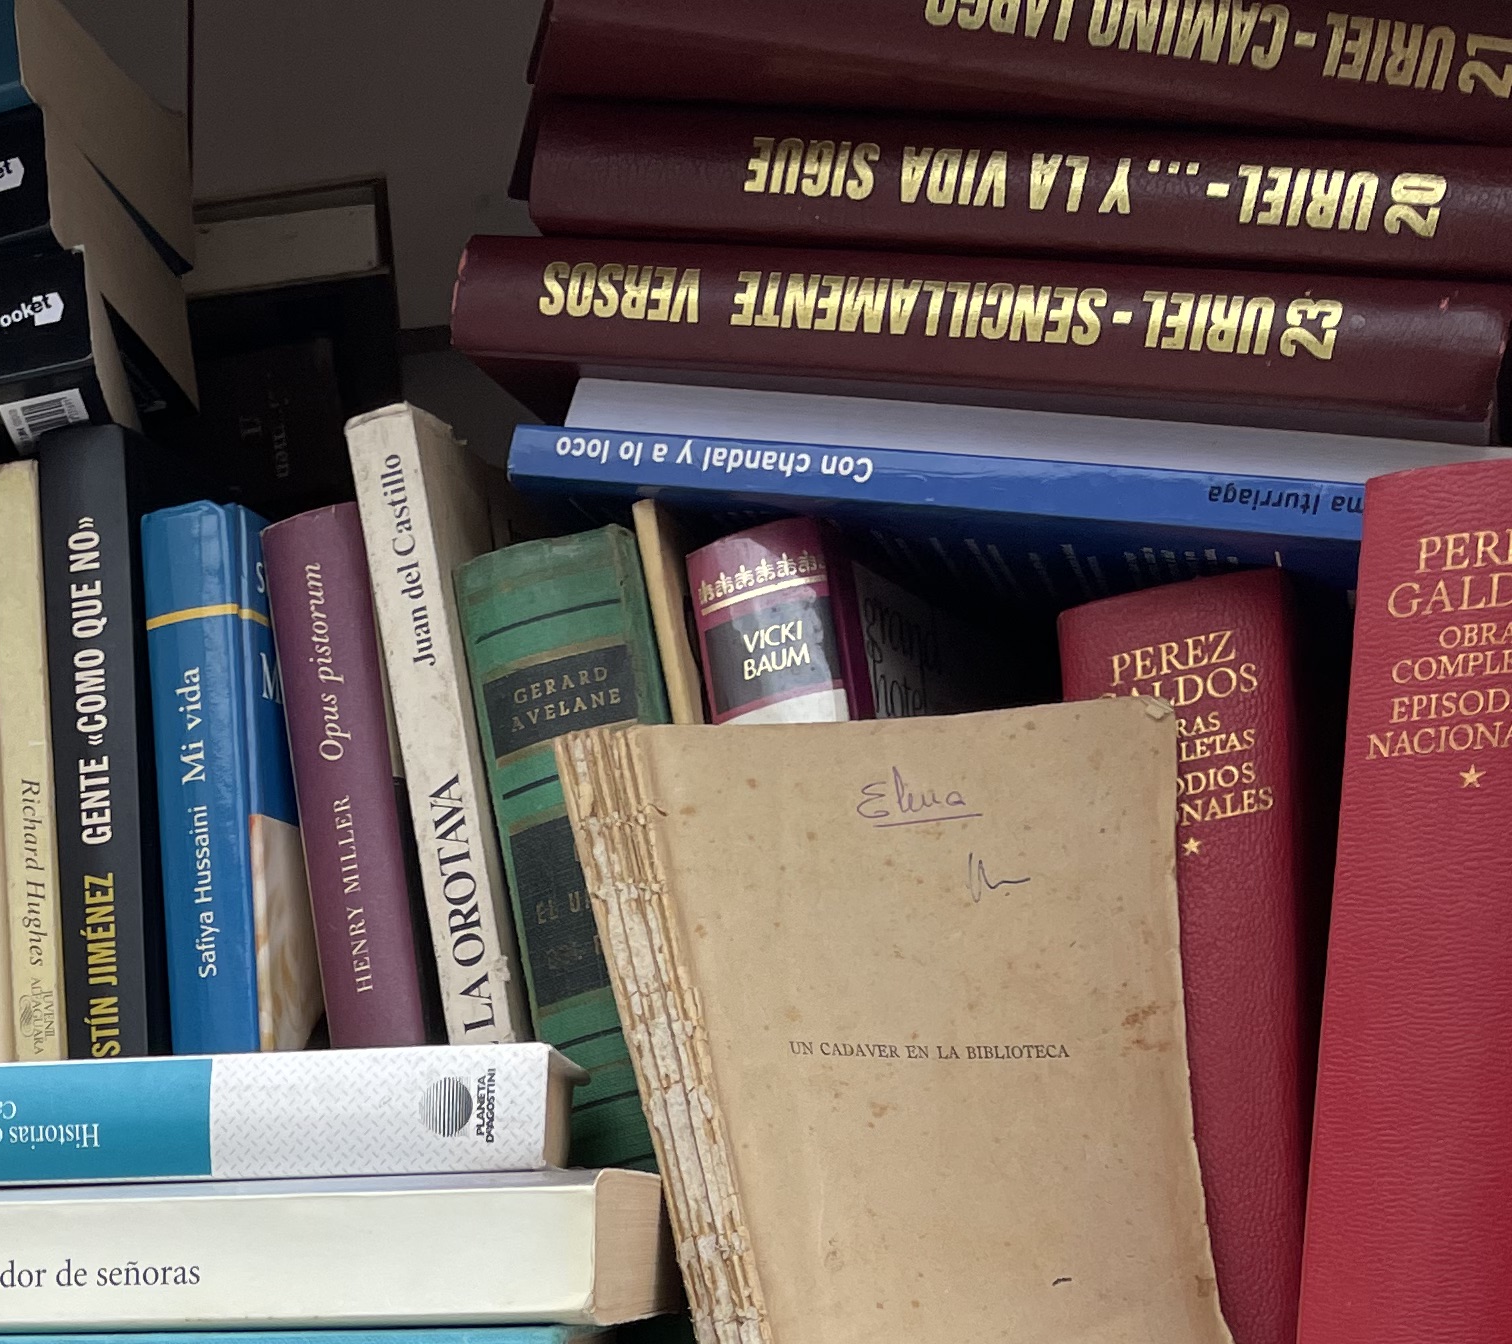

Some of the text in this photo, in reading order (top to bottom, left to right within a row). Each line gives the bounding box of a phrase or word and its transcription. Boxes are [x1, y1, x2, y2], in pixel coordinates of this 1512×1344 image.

[539, 260, 1275, 358] URIEL SENCILLAMENTE VERSOS
[555, 434, 874, 484] Con chandal loco
[385, 453, 437, 668] Juan del Castillo
[743, 620, 803, 653] VICKI
[743, 643, 811, 681] BAUM
[1110, 630, 1237, 686] PEREZ
[511, 688, 622, 732] AVELANE
[513, 667, 608, 705] GERARD
[66, 515, 120, 985] JIMÉNEZ GENTE «COMO QUE NO»
[302, 562, 375, 994] HENRY MILLER Opus pistorum
[174, 667, 217, 978] Safiya Hussaini Mi vida
[20, 778, 47, 967] Richard Hughes
[427, 773, 496, 1035] LA OROTAVA
[789, 1041, 1070, 1060] UN CADAVER EN LA BIBLIOTECA
[476, 1075, 486, 1136] PLANETA
[16, 1122, 101, 1150] Historias
[56, 1261, 88, 1287] de
[96, 1261, 201, 1287] señoras
